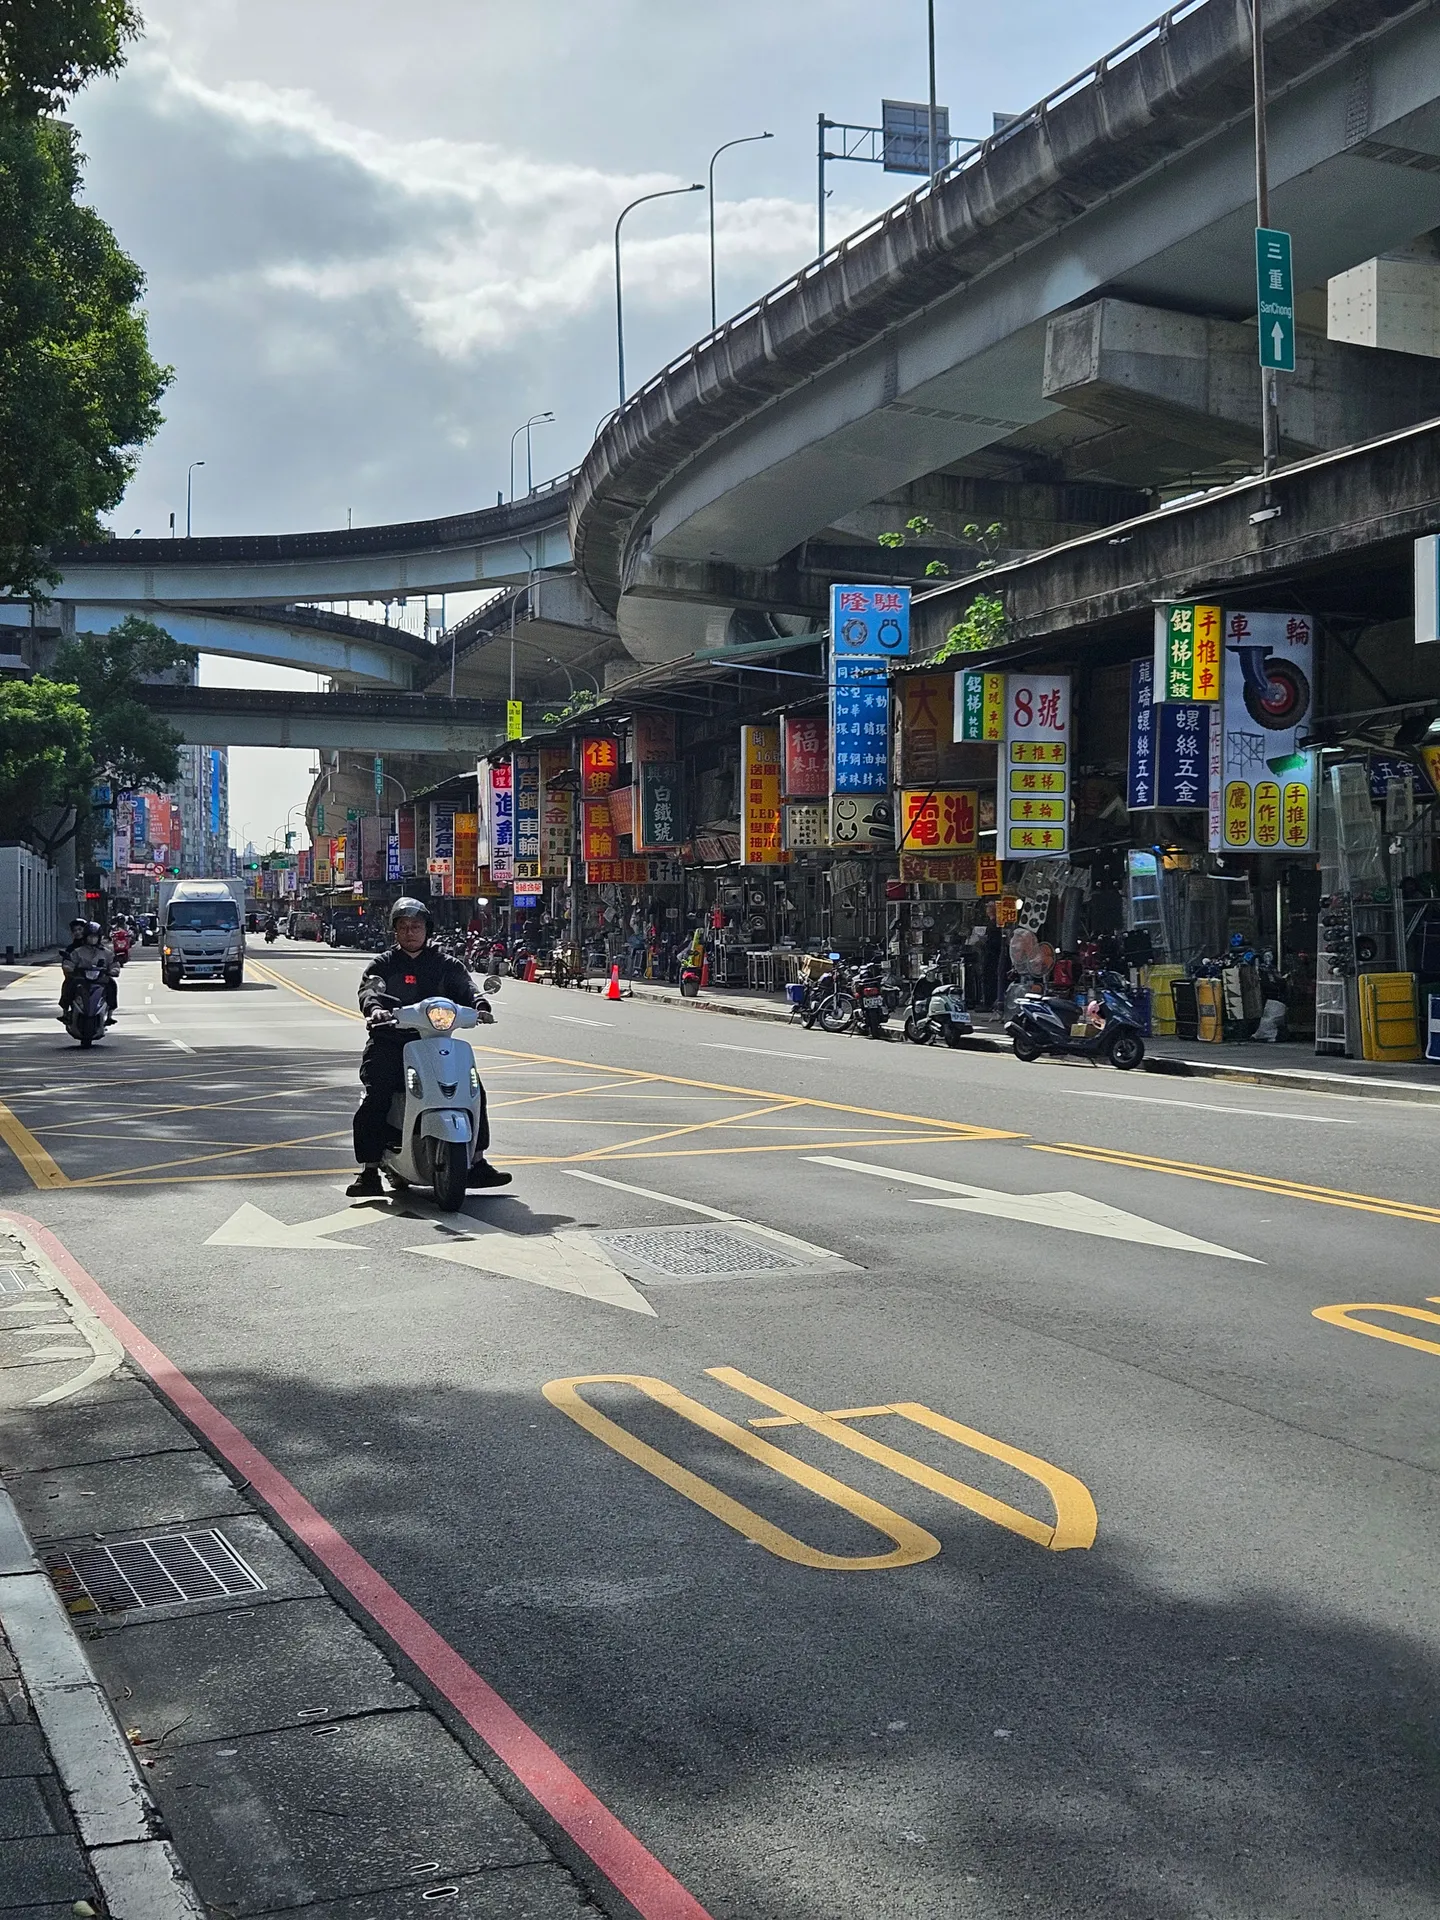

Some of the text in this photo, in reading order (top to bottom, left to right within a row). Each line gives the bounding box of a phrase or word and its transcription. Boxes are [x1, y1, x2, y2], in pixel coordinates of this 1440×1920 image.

[1267, 242, 1284, 291] 三重
[1260, 300, 1292, 319] SanChong
[839, 591, 903, 613] 隆騏
[1228, 614, 1310, 646] 車輪
[1170, 609, 1192, 698] 鋁梯批發
[1197, 611, 1219, 696] 手推車
[966, 675, 982, 739] 鋁梯批發
[1014, 688, 1065, 731] 8號
[792, 722, 829, 754] 福
[1014, 745, 1064, 762] 手推車
[1174, 709, 1200, 804] 螺絲五金
[586, 740, 616, 794] 佳興
[750, 764, 782, 776] 送風
[1022, 773, 1055, 790] 鋁梯
[653, 785, 674, 842] 白鐵號
[908, 795, 974, 846] 電池
[1022, 801, 1053, 819] 車輪
[1229, 787, 1247, 840] 鷹架
[1258, 786, 1276, 842] 工作架
[1287, 785, 1306, 842] 手推車
[518, 817, 539, 857] 車輪
[589, 805, 612, 857] 車輪
[1022, 831, 1053, 848] 板車
[589, 862, 623, 881] 手推車
[650, 861, 682, 881] 電子秤
[980, 856, 998, 892] 出風口
